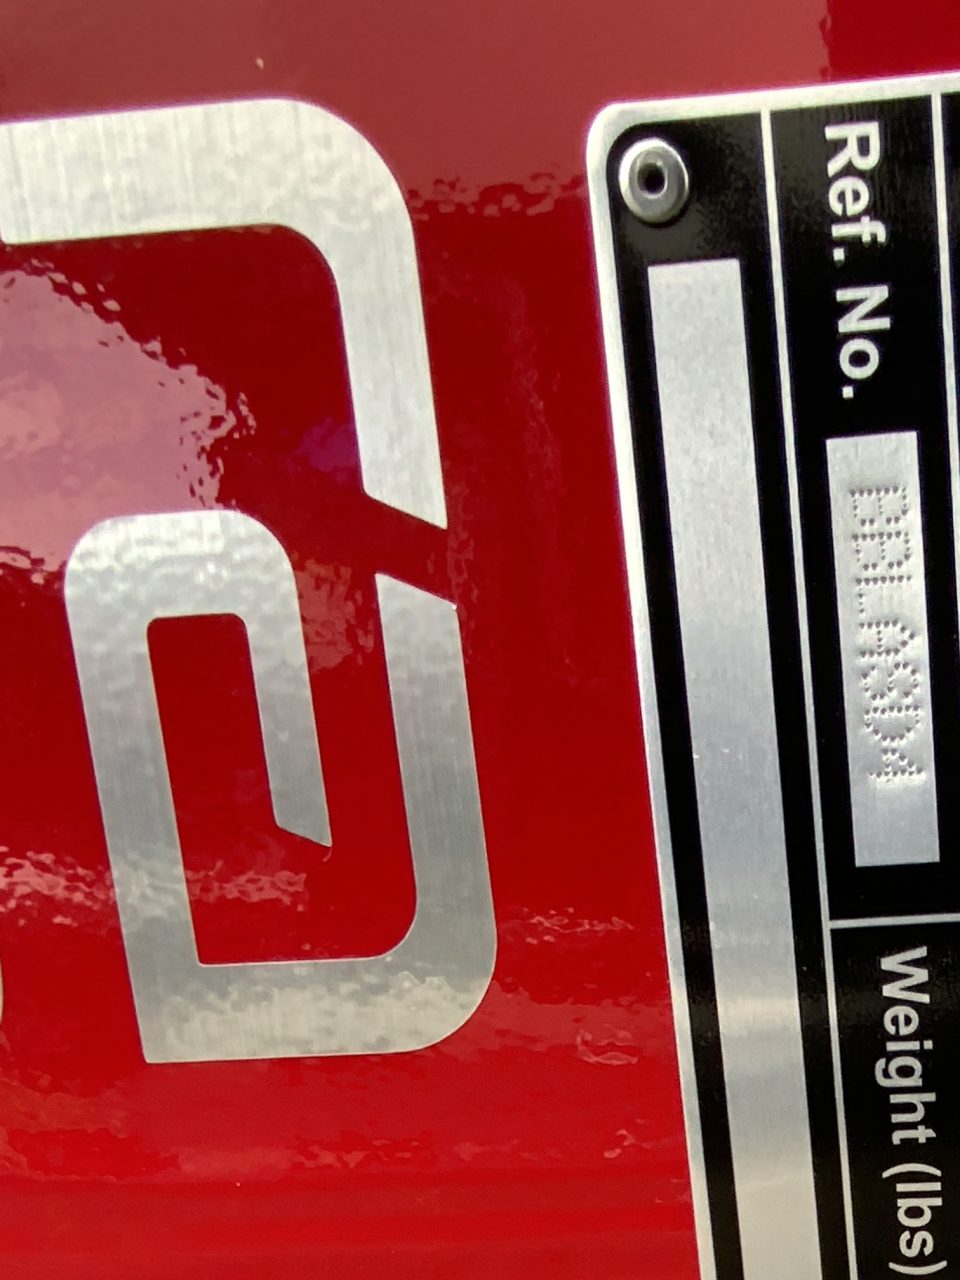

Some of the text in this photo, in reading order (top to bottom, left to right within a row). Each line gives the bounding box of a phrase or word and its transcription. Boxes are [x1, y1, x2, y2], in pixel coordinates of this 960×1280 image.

[825, 120, 926, 783] Ref. No. BBLASD4
[875, 946, 936, 1145] Weight
[882, 1163, 947, 1275] (lbs)
